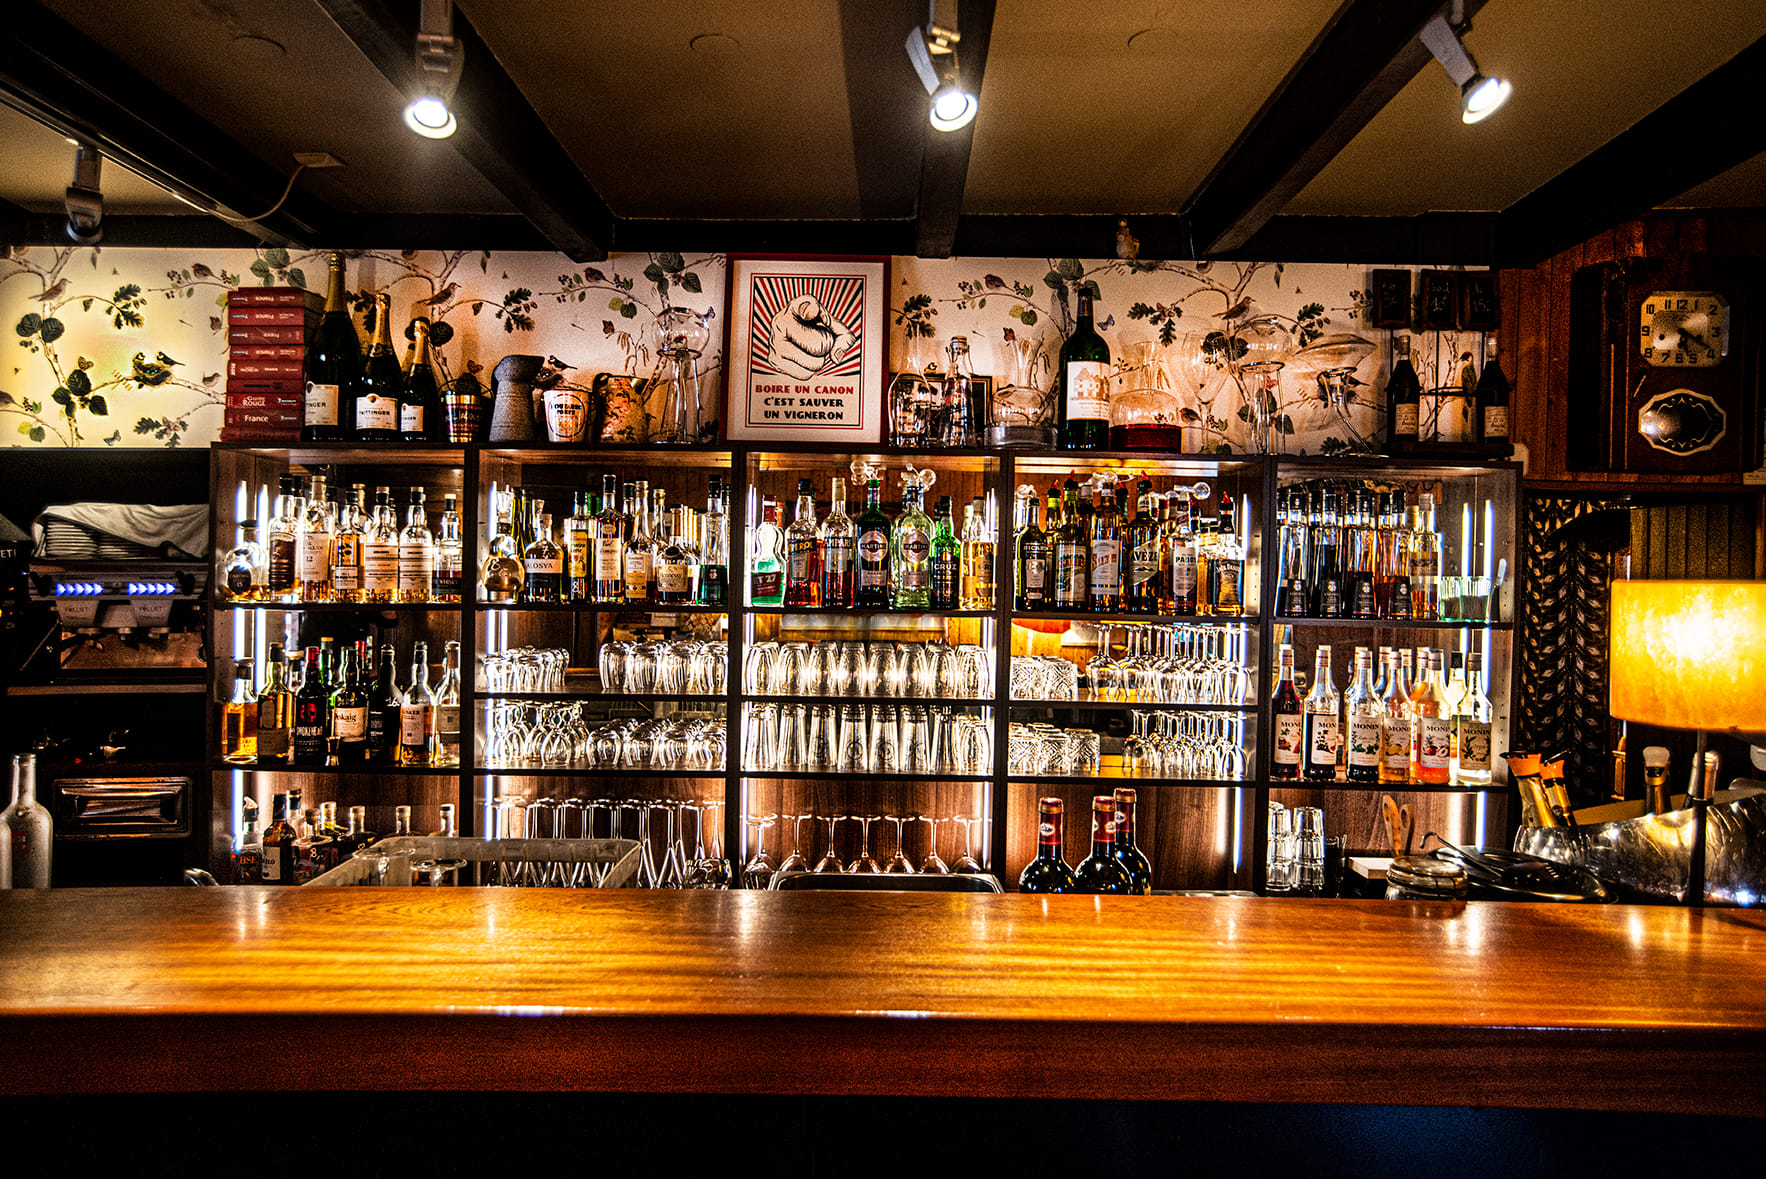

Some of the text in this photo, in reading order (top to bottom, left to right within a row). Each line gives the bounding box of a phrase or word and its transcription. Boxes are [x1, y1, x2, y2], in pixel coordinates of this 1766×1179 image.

[1646, 304, 1655, 314] 10
[1664, 299, 1672, 310] 11
[1676, 299, 1688, 310] 12
[1694, 300, 1698, 310] 1
[1709, 304, 1718, 315] 2
[1642, 326, 1650, 336] 9
[1712, 327, 1720, 337] 3
[1644, 348, 1652, 358] 8
[1662, 352, 1670, 363] 7
[1689, 353, 1698, 363] 5
[1707, 348, 1715, 359] 4
[1676, 353, 1683, 364] 6
[755, 384, 854, 394] BOIRE UN CANON
[764, 396, 844, 407] C'EST SAUVER
[764, 410, 843, 420] UN VIGNERON
[934, 564, 958, 572] CRUZ
